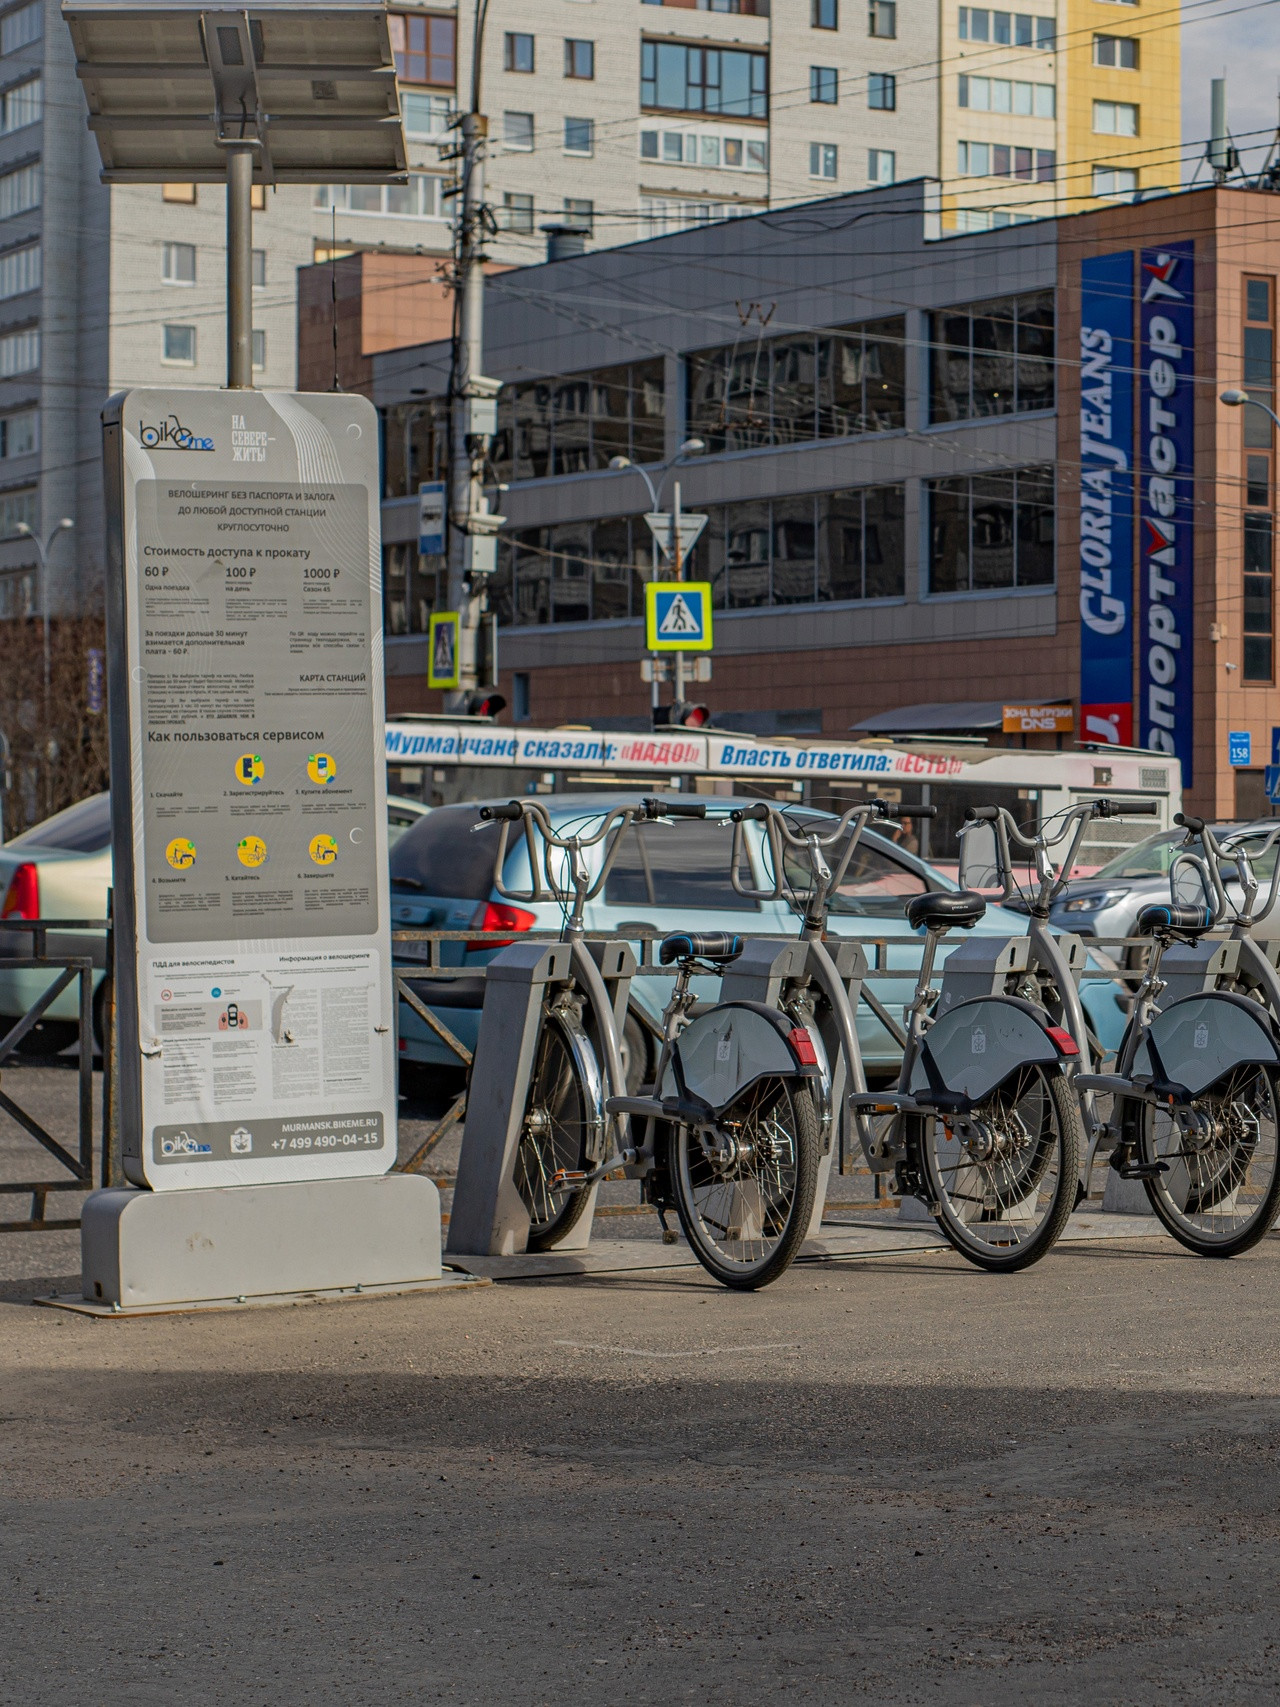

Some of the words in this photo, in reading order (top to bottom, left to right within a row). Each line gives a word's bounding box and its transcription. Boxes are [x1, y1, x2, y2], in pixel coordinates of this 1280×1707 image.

[1080, 326, 1128, 471] JEANS
[231, 414, 246, 430] НА
[168, 490, 229, 499] ВЕЛОШЕРИНГ
[231, 491, 247, 500] БЕЗ
[249, 491, 293, 501] ПАСПОРТА
[294, 492, 301, 500] И
[304, 493, 335, 502] ЗАЛОГА
[178, 506, 191, 516] ДО
[193, 505, 226, 516] ЛЮБОЙ
[229, 506, 283, 517] ДОСТУПНОЙ
[284, 508, 326, 518] СТАНЦИИ
[217, 523, 289, 533] КРУГЛОСУТОЧНО
[144, 546, 205, 558] Стоимость
[207, 548, 253, 560] доступа
[256, 549, 262, 557] к
[265, 549, 310, 561] прокату
[1080, 466, 1126, 635] GLORIA
[144, 566, 159, 577] 60
[226, 567, 247, 578] 100
[303, 568, 331, 579] 1000
[300, 674, 325, 682] КАРТА
[326, 673, 366, 683] СТАНЦИЙ
[1021, 718, 1056, 729] DNS
[148, 731, 170, 742] Как
[174, 731, 260, 742] пользоваться
[263, 730, 324, 743] сервисом
[385, 731, 517, 757] Мурманчане
[523, 740, 617, 761] сказали:
[721, 745, 791, 768] Власть
[796, 750, 892, 773] ответила:
[1231, 747, 1249, 759] 158
[182, 959, 235, 967] велосипедистов
[279, 955, 322, 964] Информация
[282, 1118, 378, 1133] MURMANSK.BIKEME.RU
[271, 1138, 287, 1150] +7
[289, 1137, 312, 1149] 499
[314, 1132, 378, 1148] 490-04-15
